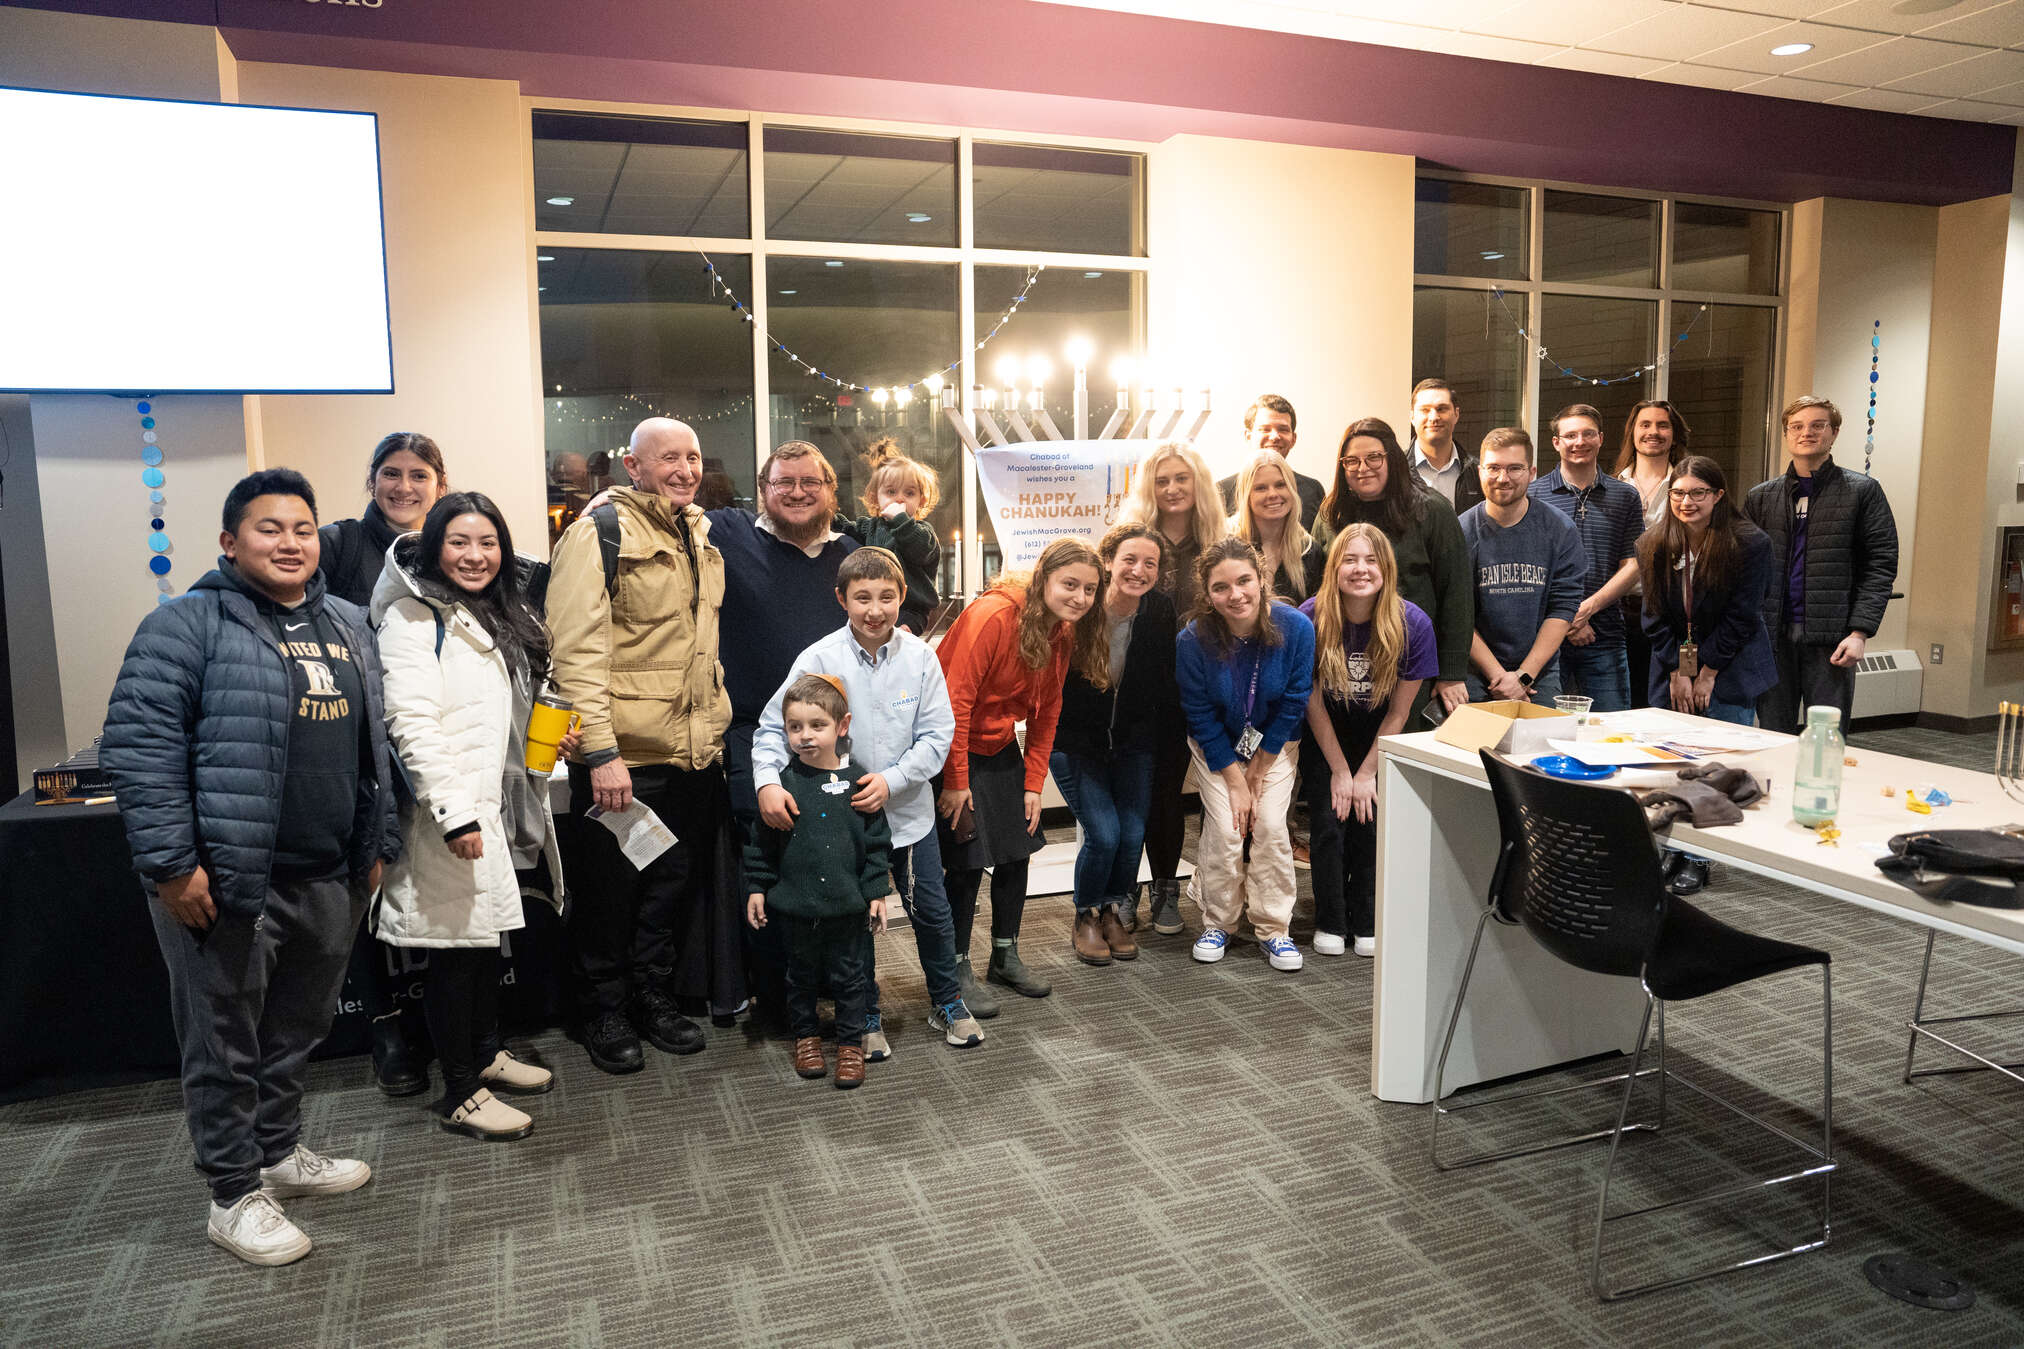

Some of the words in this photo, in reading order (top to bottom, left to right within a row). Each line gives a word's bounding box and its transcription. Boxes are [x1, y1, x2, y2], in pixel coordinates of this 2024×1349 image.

[1030, 453, 1060, 461] Chabad
[1006, 463, 1094, 472] Macalester-Groveland
[1026, 475, 1052, 483] wishes
[1054, 475, 1069, 484] you
[1019, 492, 1077, 506] HAPPY
[1000, 504, 1101, 520] CHANUKAH!
[1012, 527, 1092, 536] JewishMacGrove.org
[1501, 563, 1520, 584] ISLE
[1520, 563, 1546, 586] BEAC
[278, 641, 322, 658] NITED
[326, 643, 350, 662] WE
[892, 696, 919, 707] CHABAD
[298, 697, 350, 721] STAND
